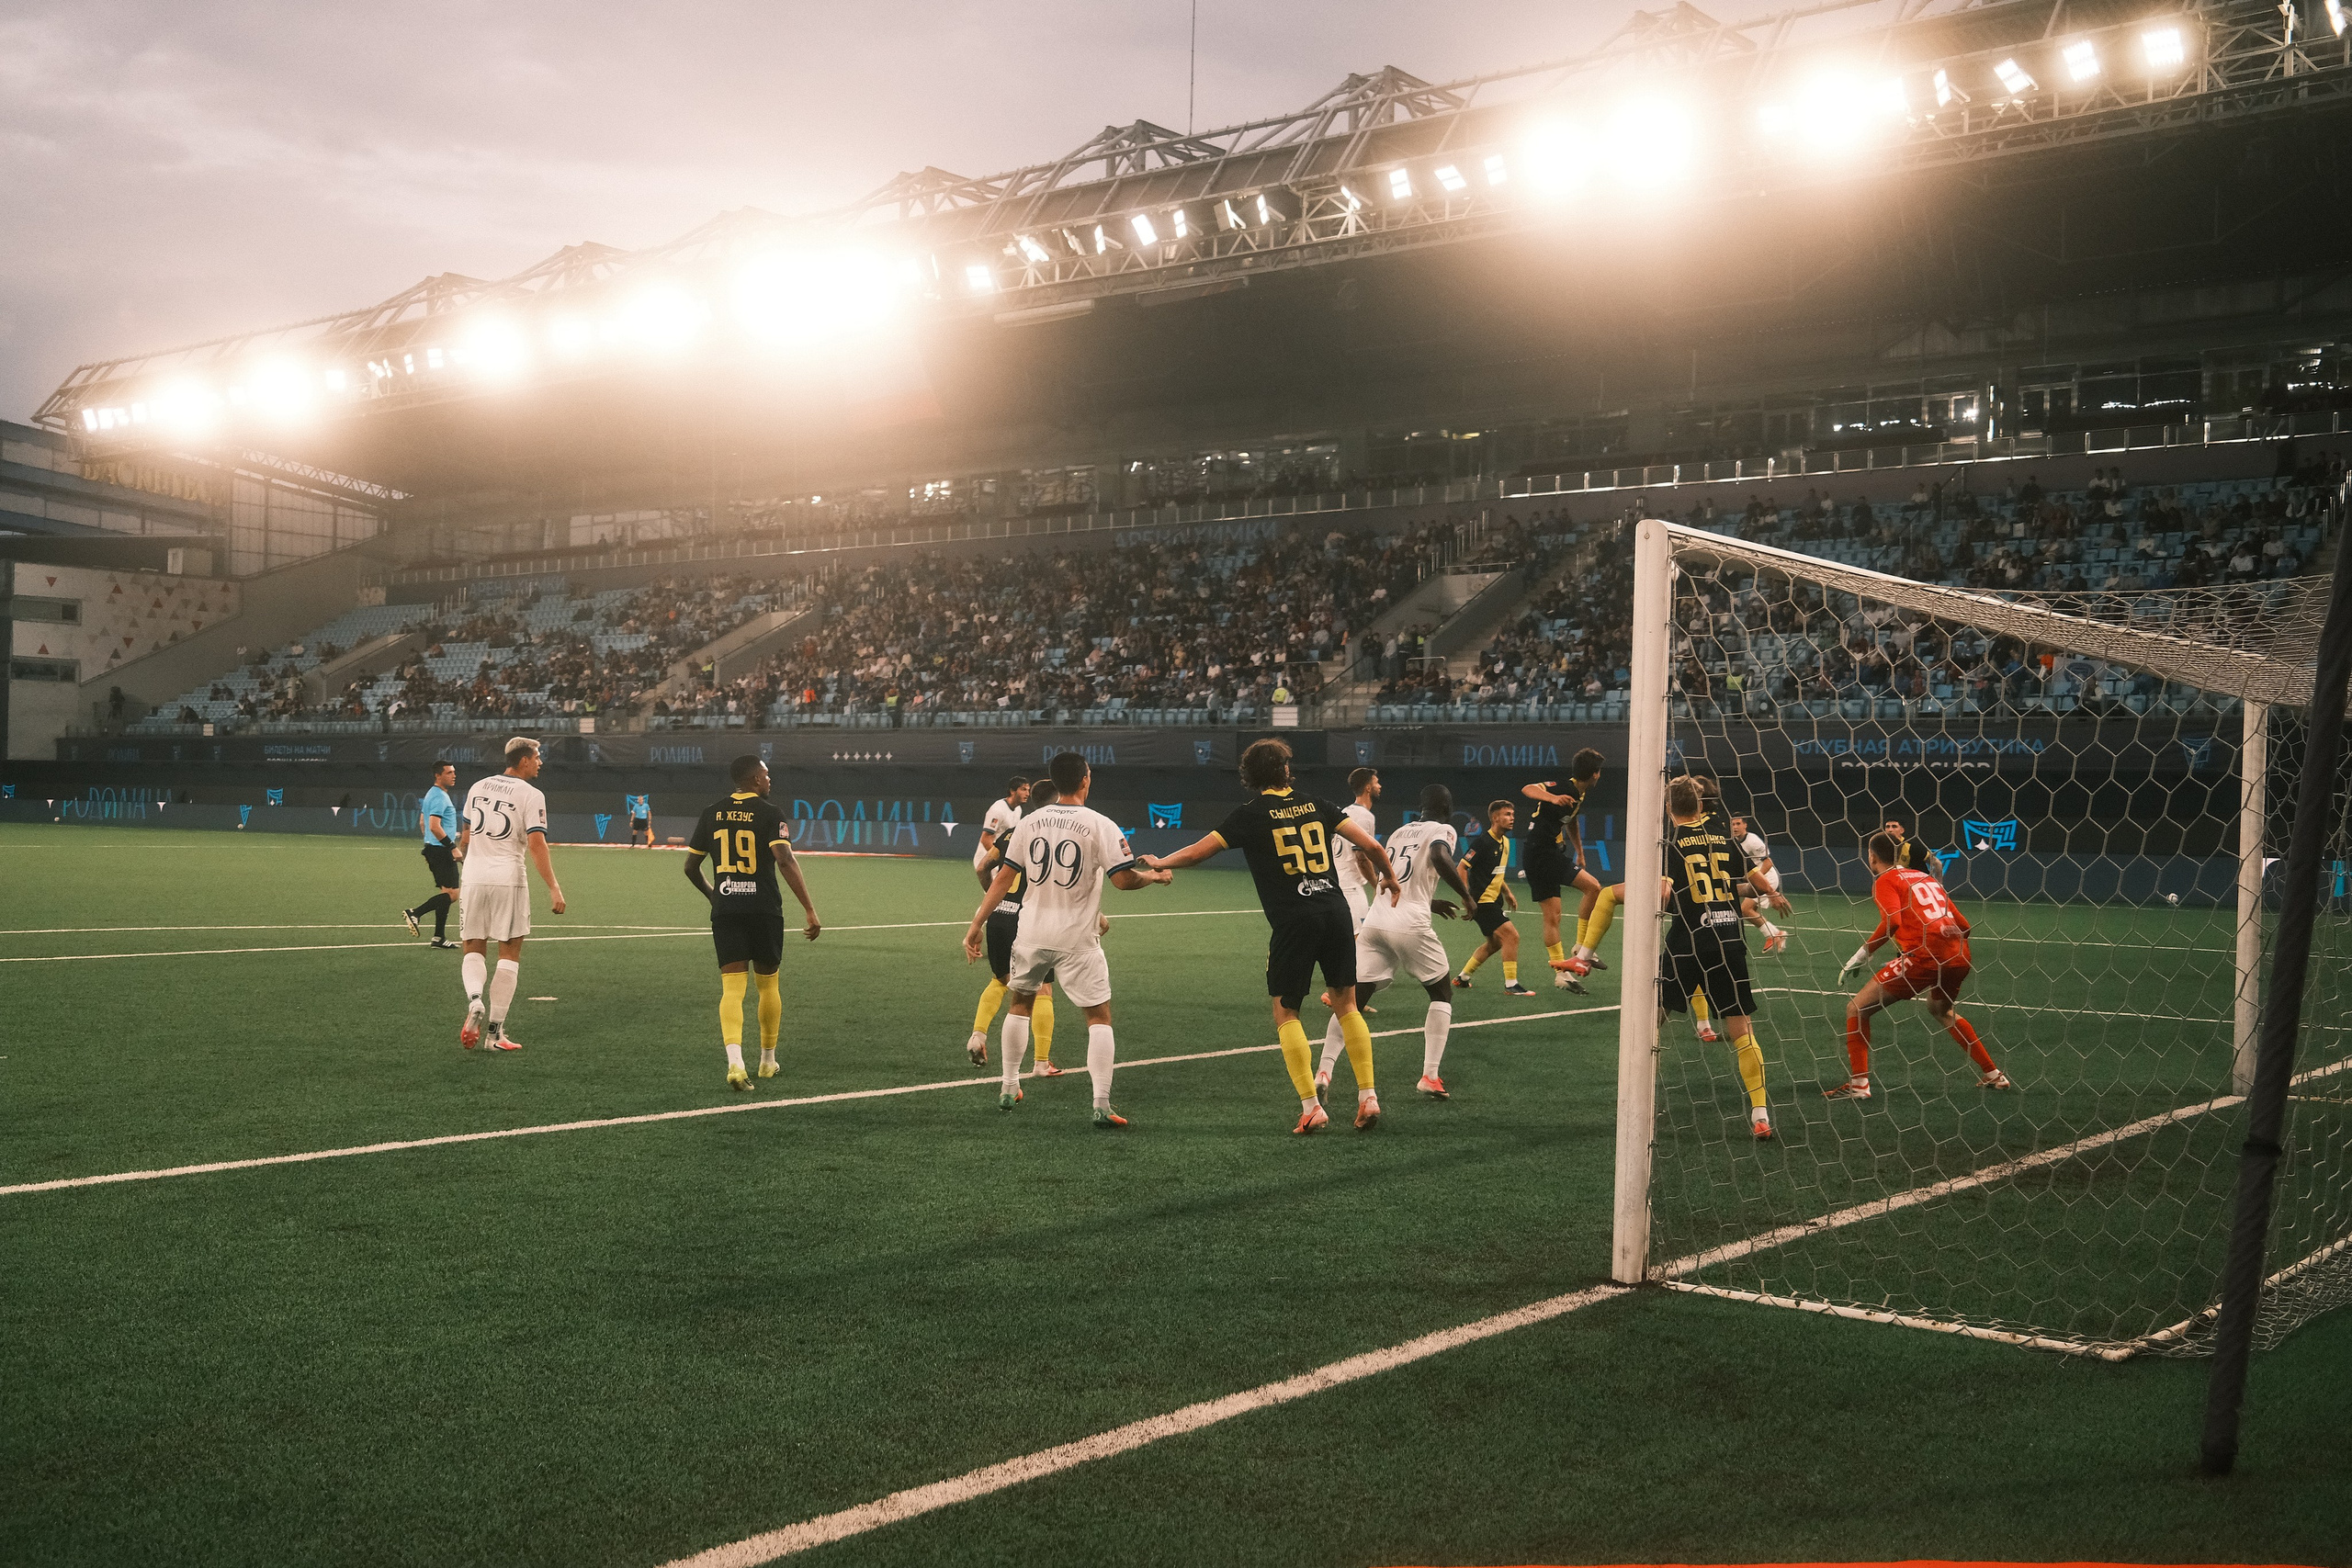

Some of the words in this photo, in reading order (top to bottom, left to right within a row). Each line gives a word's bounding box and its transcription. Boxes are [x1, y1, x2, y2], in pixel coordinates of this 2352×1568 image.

[1793, 739, 1890, 754] КЛУБНАЯ
[1897, 739, 2045, 754] АТРИБУТИКА
[470, 795, 516, 840] 55
[716, 811, 724, 821] А.
[726, 810, 754, 822] ЖЕЗУС
[1029, 817, 1091, 838] ТИМОШЕНКО
[1269, 802, 1317, 819] СЫЩЕНКО
[713, 829, 757, 874] 19
[1029, 837, 1085, 890] 99
[1272, 820, 1330, 875] 59
[1684, 852, 1735, 904] 65
[1911, 882, 1953, 919] 95
